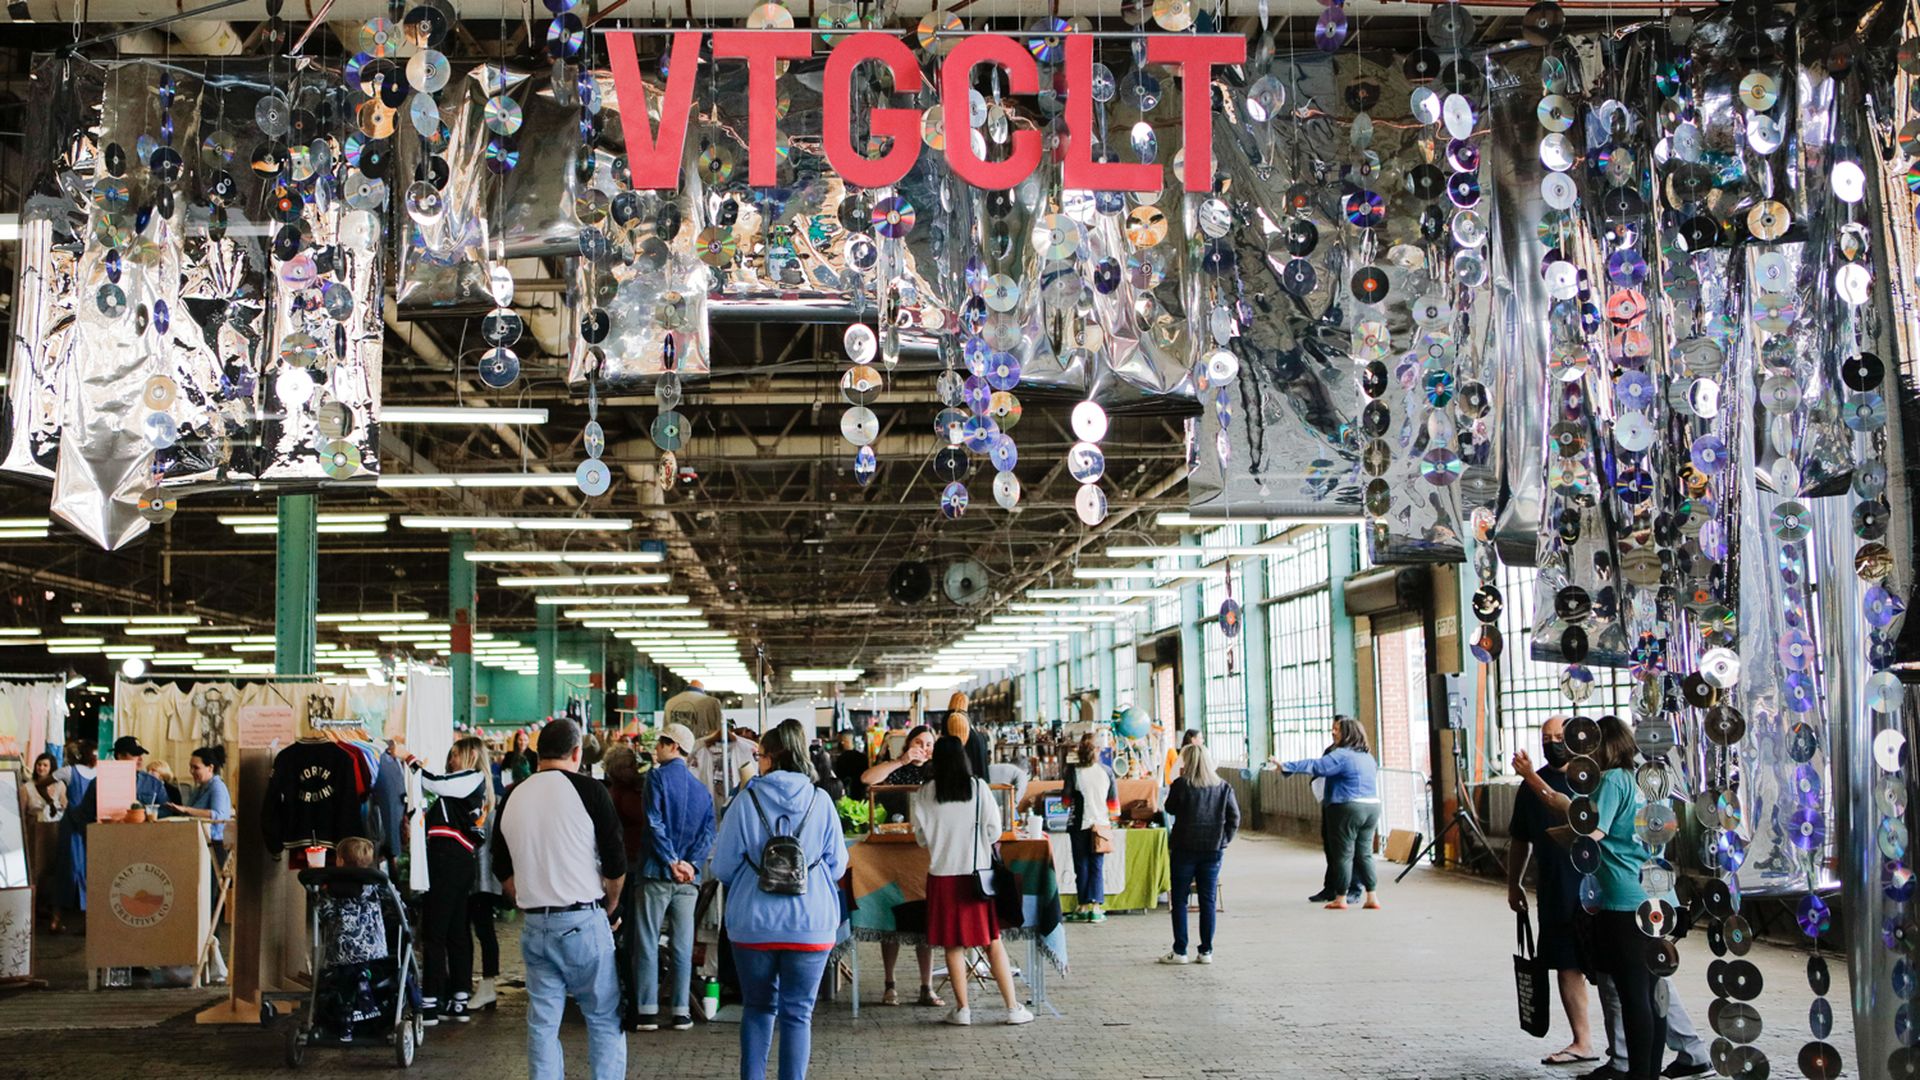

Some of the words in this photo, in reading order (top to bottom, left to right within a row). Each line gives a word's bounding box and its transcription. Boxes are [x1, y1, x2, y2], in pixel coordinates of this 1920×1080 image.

[113, 866, 134, 889] SALT
[145, 864, 170, 886] LIGHT
[113, 903, 155, 925] CREATIVE
